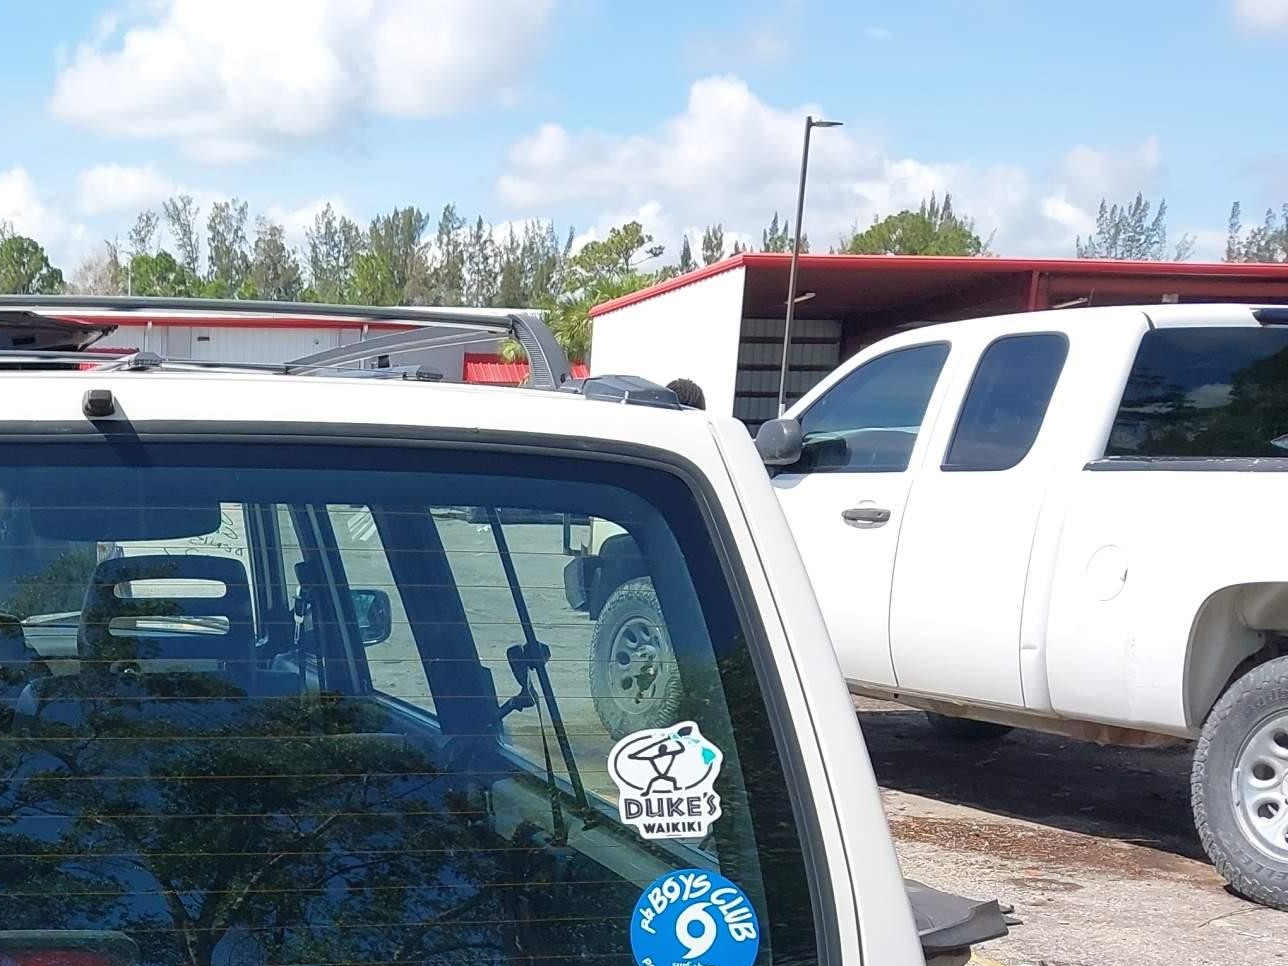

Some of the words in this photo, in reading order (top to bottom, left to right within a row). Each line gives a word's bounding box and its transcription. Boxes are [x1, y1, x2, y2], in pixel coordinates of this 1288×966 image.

[624, 792, 717, 819] DUKE'S
[643, 821, 702, 834] WAIKIKI
[710, 888, 756, 941] CLUB
